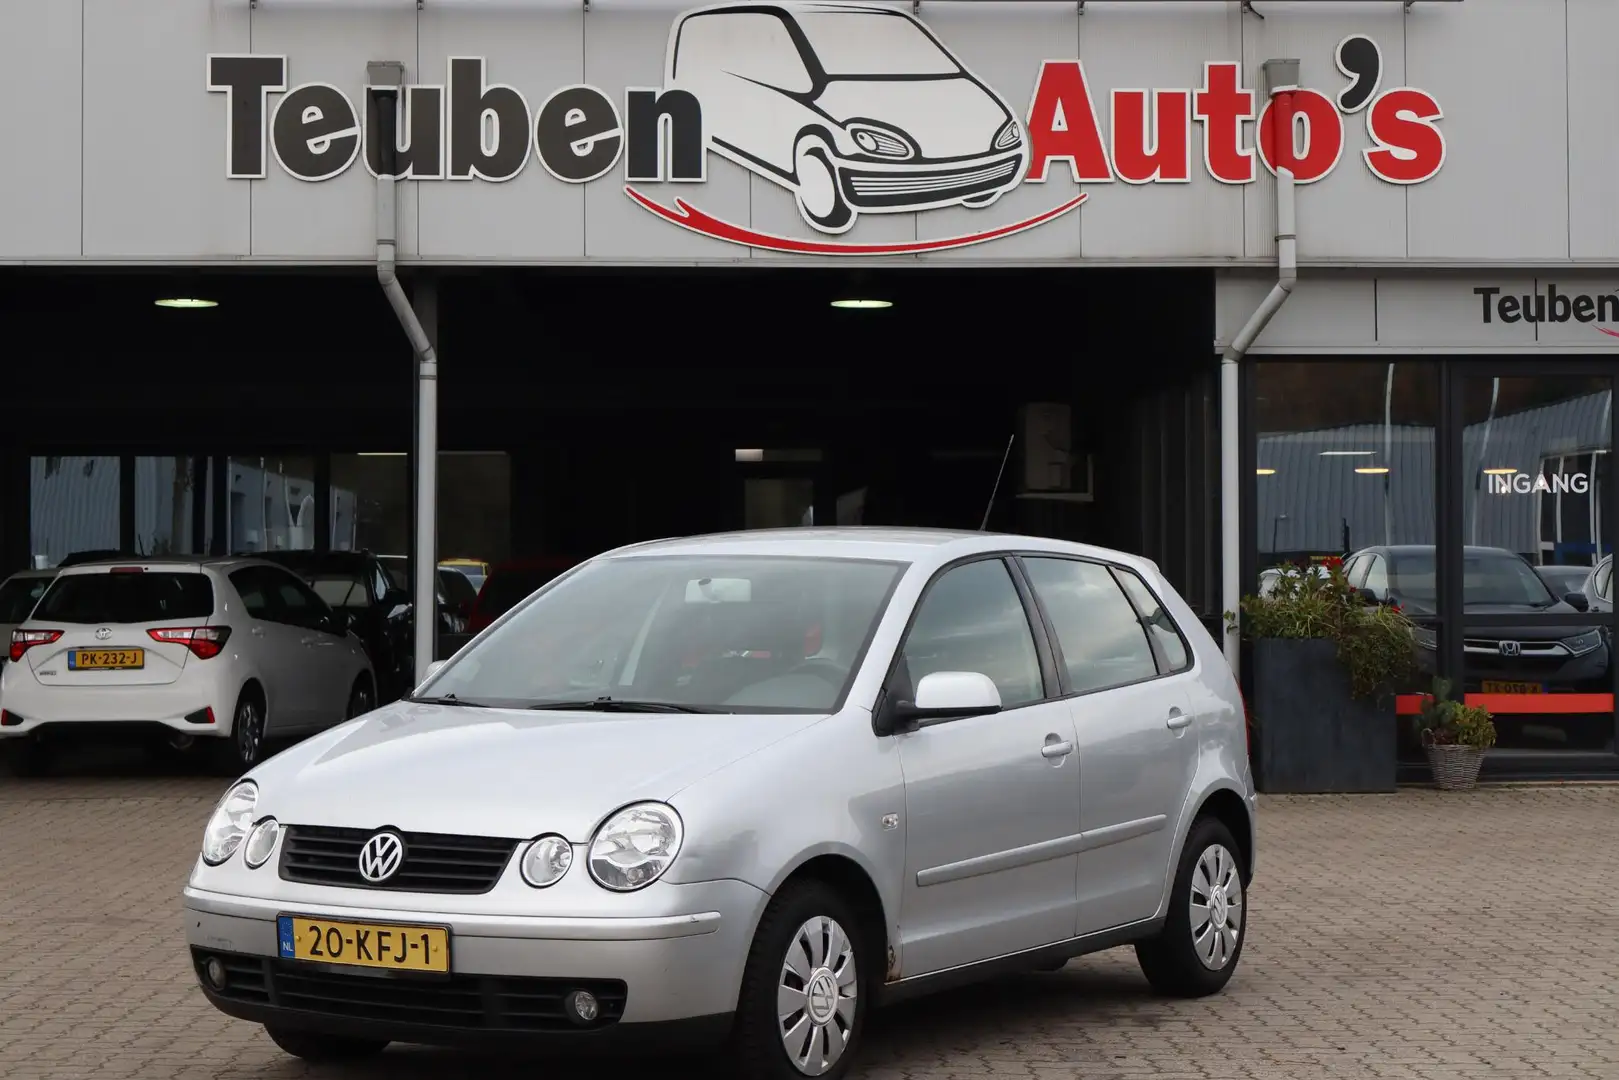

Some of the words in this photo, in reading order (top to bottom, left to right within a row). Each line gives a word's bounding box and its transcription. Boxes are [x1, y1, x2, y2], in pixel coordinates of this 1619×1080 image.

[207, 54, 707, 182] Teuben
[1025, 34, 1447, 185] Auto's
[1473, 284, 1619, 323] Teuben
[1487, 473, 1589, 494] INGANG
[81, 653, 137, 665] PK-232-J
[282, 941, 294, 952] NL
[309, 925, 430, 965] 20-KFJ-1
